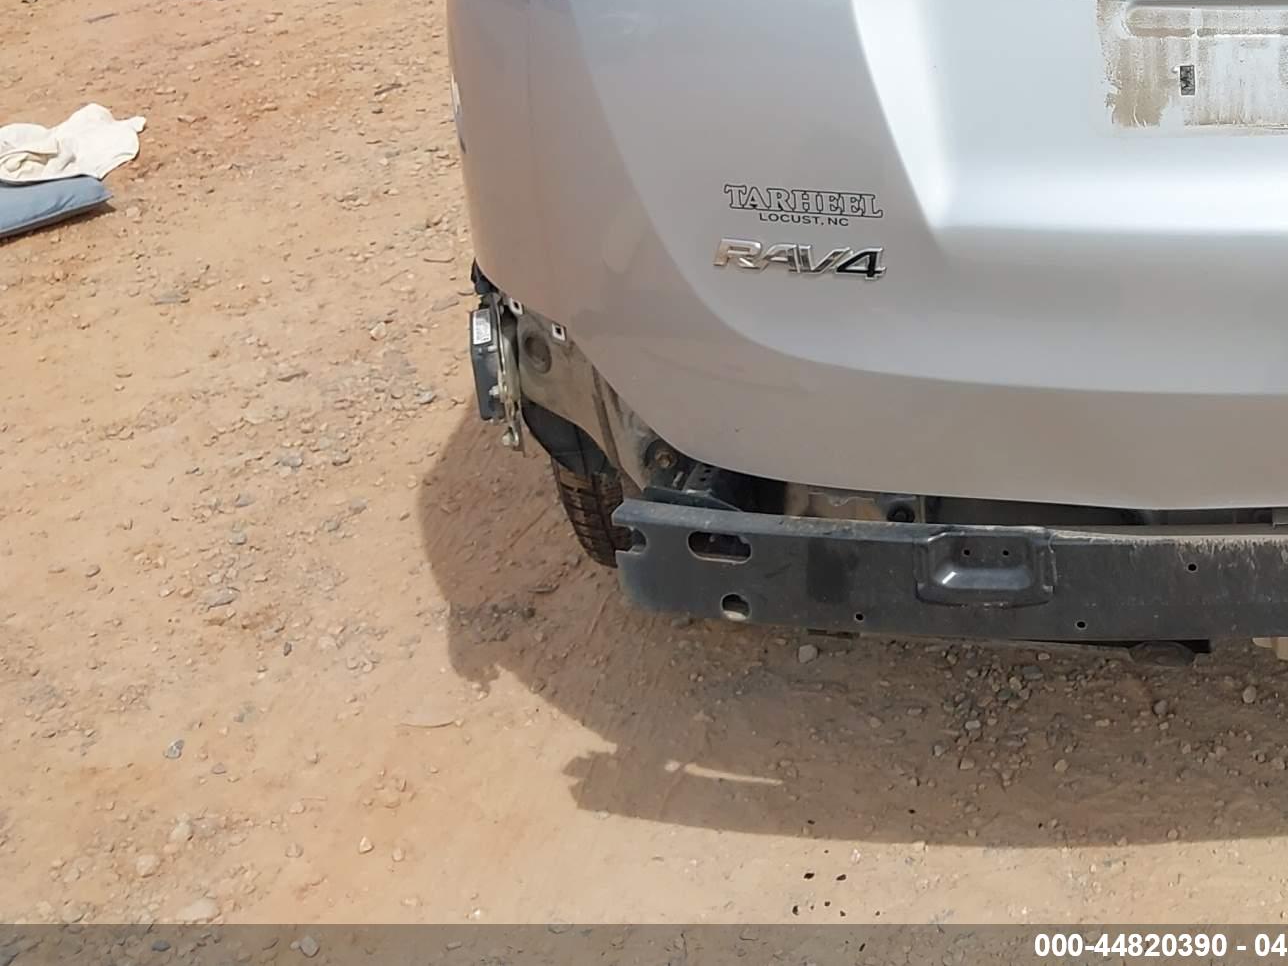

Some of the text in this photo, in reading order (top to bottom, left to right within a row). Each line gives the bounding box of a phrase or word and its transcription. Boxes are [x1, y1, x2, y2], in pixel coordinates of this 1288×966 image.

[724, 184, 884, 218] TARHEEL
[827, 216, 850, 227] NC
[713, 237, 888, 282] RAV4
